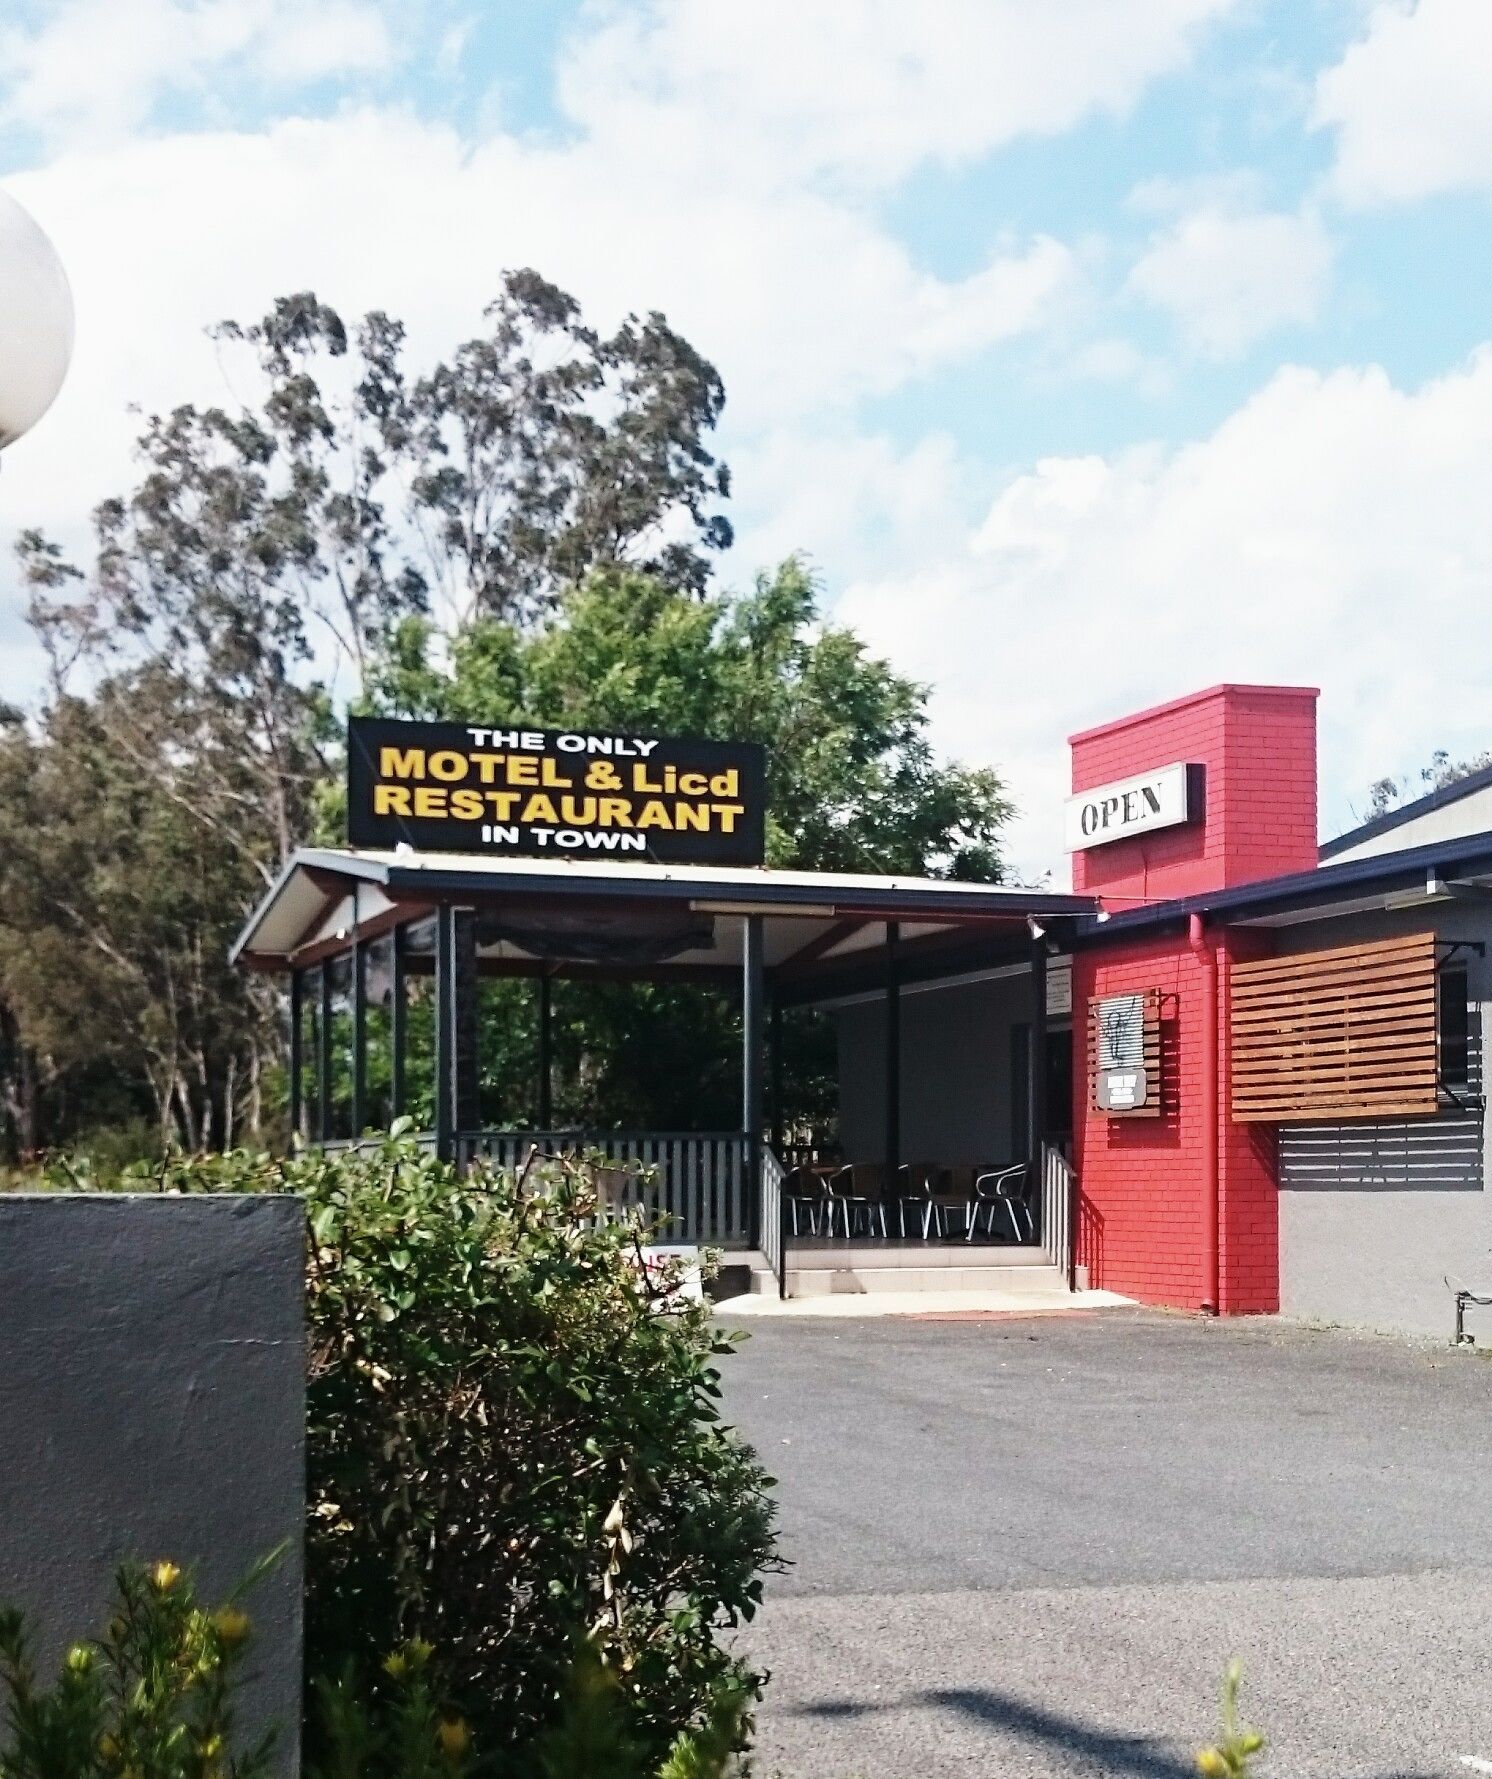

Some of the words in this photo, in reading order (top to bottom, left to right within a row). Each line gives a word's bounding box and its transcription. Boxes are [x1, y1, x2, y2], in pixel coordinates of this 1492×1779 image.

[466, 728, 546, 752] THE
[556, 734, 659, 757] ONLY
[379, 747, 573, 789] MOTEL
[583, 760, 624, 791] &
[632, 763, 739, 798] Licd
[373, 785, 745, 834] RESTAURANT
[1081, 782, 1163, 836] OPEN
[481, 825, 520, 844] IN
[530, 828, 647, 851] TOWN
